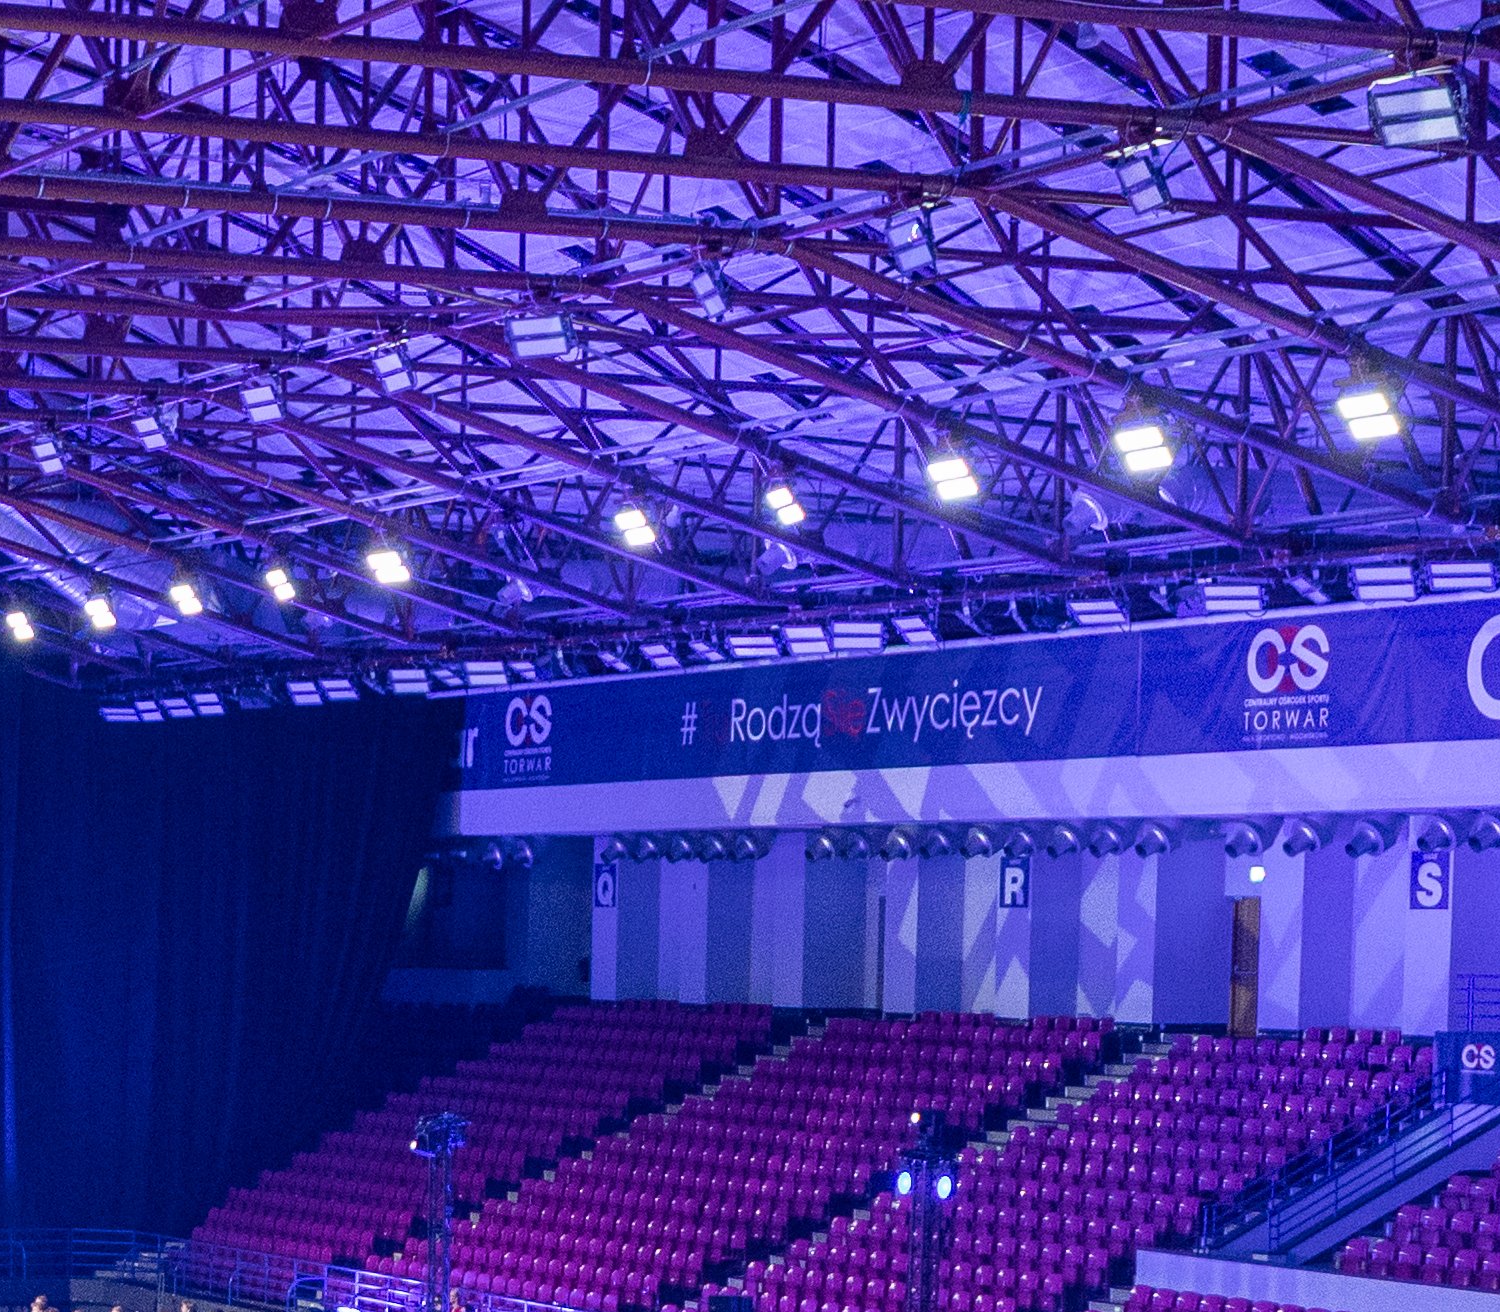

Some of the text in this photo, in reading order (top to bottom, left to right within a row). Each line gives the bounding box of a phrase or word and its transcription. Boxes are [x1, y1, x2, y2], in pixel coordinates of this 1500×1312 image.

[730, 694, 822, 748] Rodzą
[866, 679, 1043, 743] Zwycięzcy
[1244, 708, 1329, 731] TORWAR
[503, 756, 552, 775] TORWAR
[597, 874, 614, 905] Q
[1005, 866, 1025, 905] R
[1416, 861, 1443, 907] S
